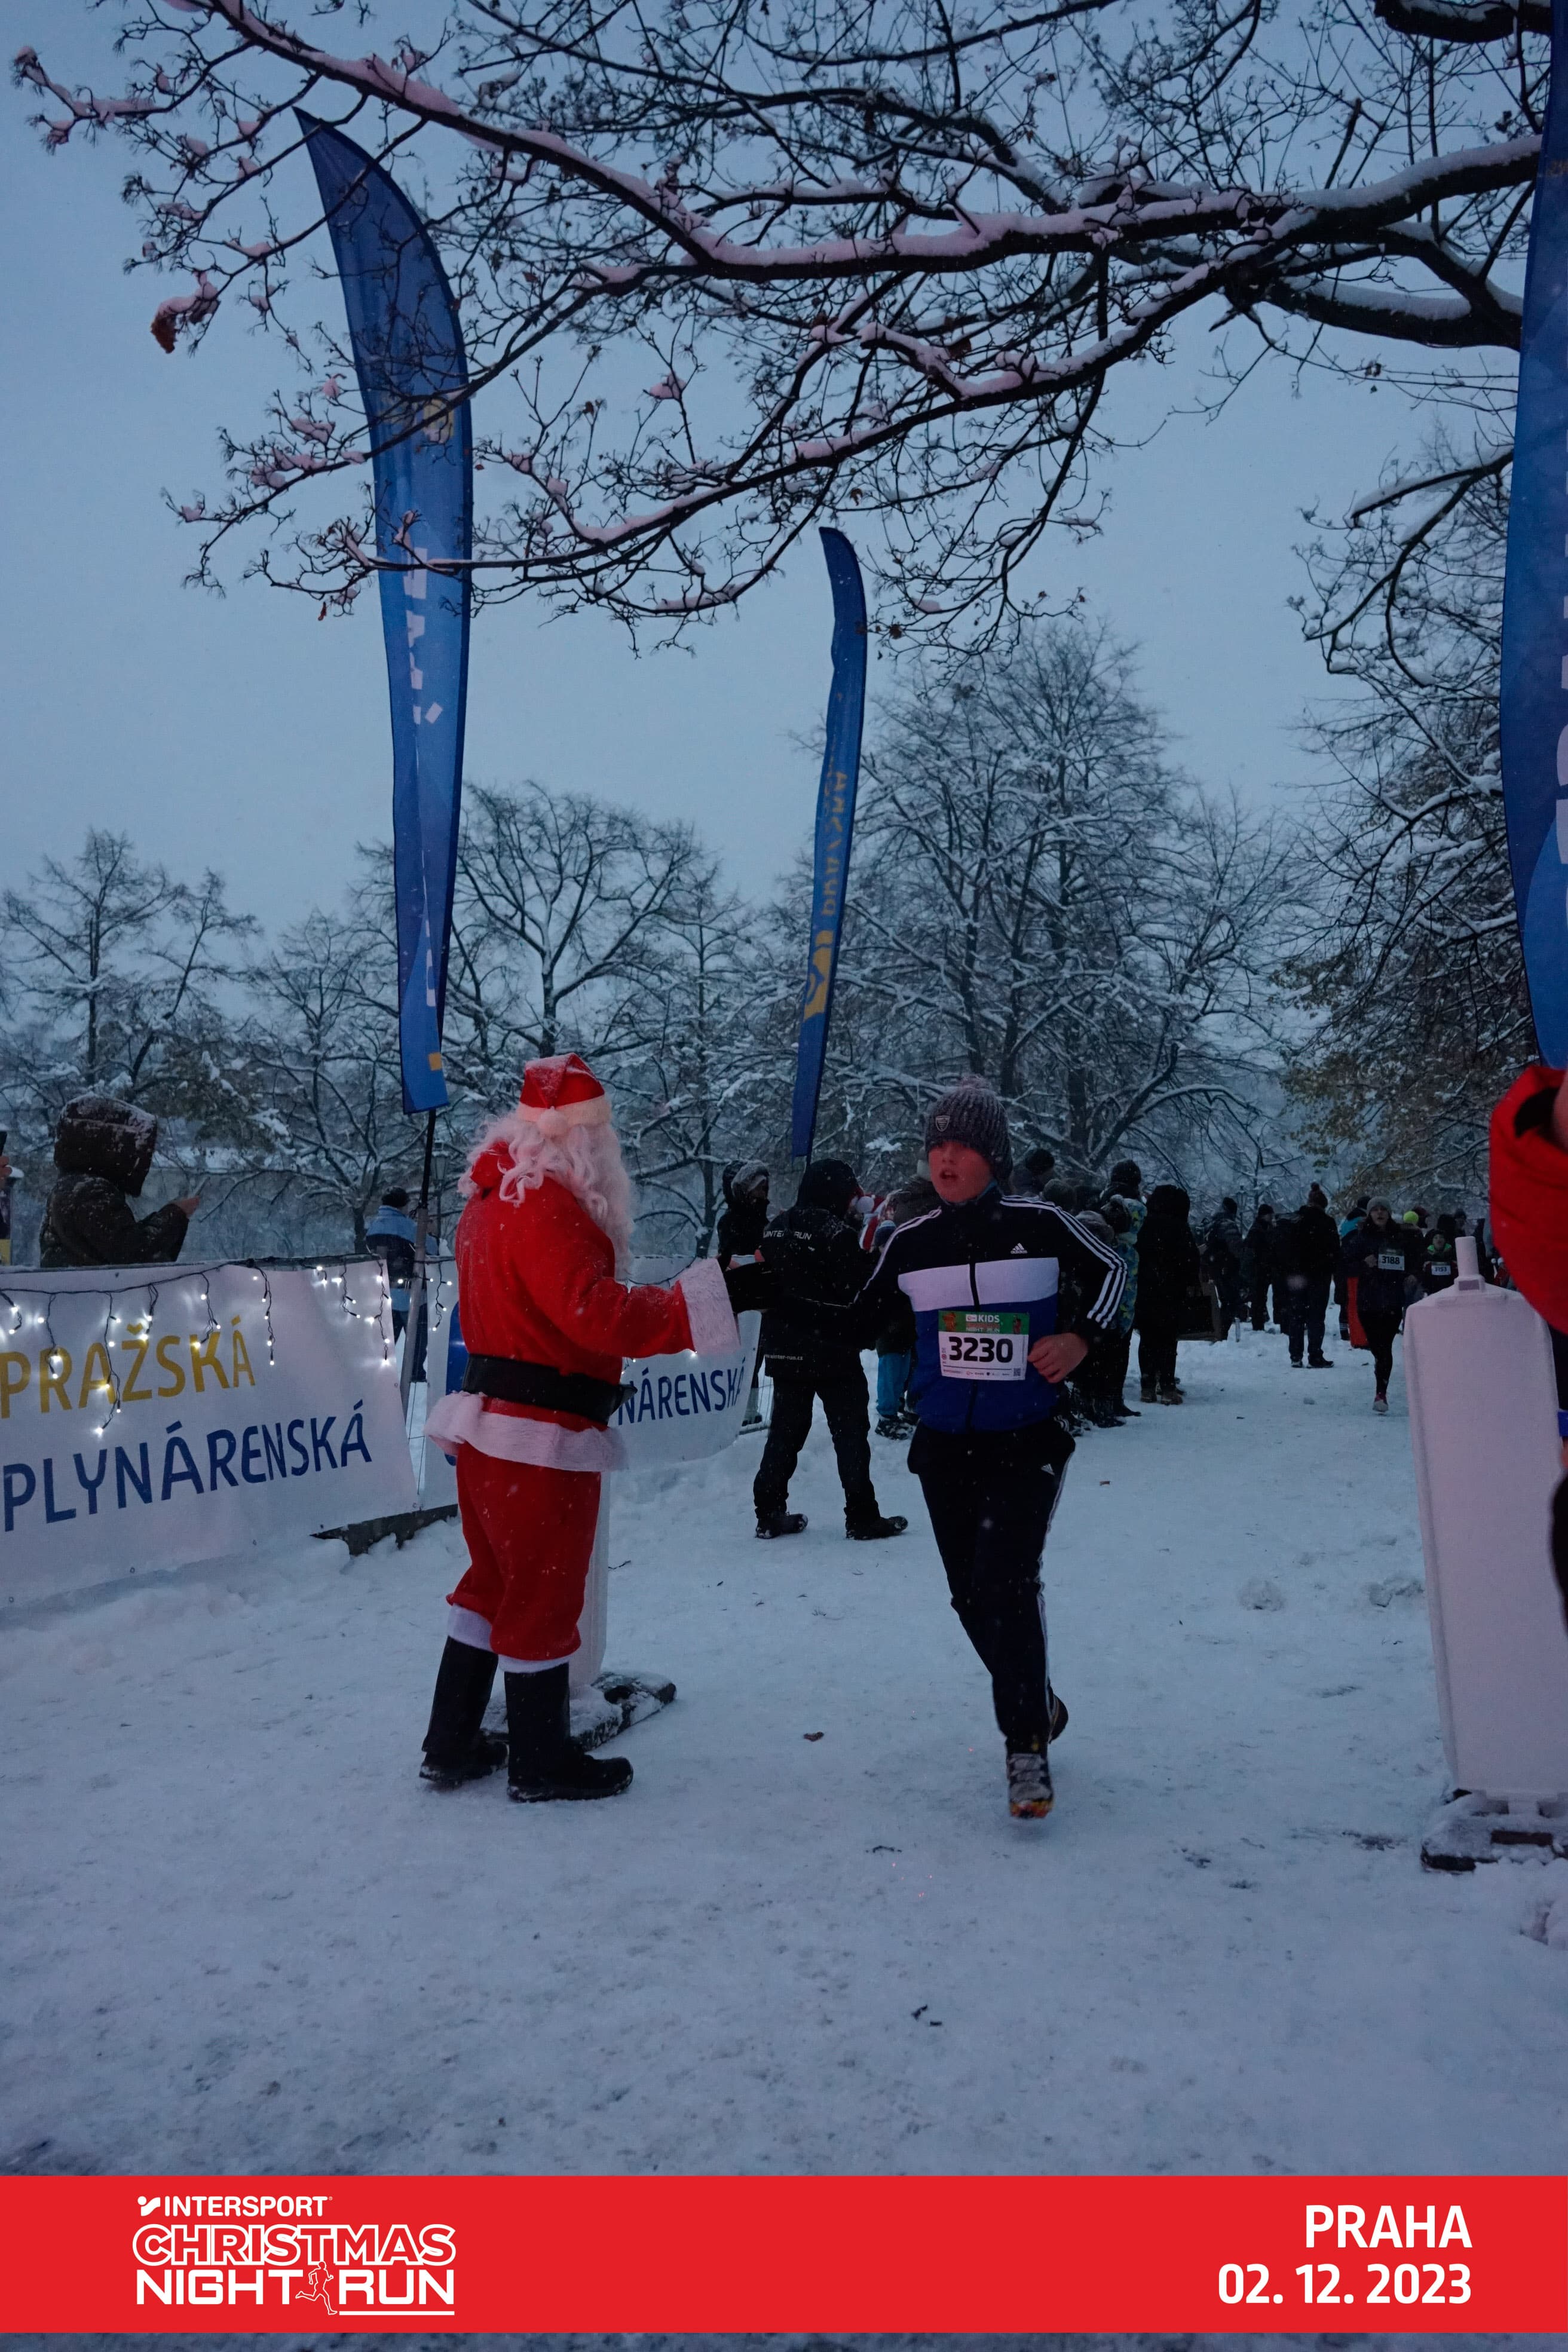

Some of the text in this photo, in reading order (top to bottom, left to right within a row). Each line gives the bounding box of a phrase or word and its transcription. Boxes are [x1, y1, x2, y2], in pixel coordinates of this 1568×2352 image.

[1382, 1255, 1400, 1264] 3188
[978, 1315, 1000, 1323] KIDS
[0, 1315, 256, 1419] PRAŽSKÁ
[949, 1336, 1013, 1363] 3230
[618, 1356, 746, 1425] NÁRENSKÁ
[2, 1399, 372, 1532] PLYNÁRENSKÁ
